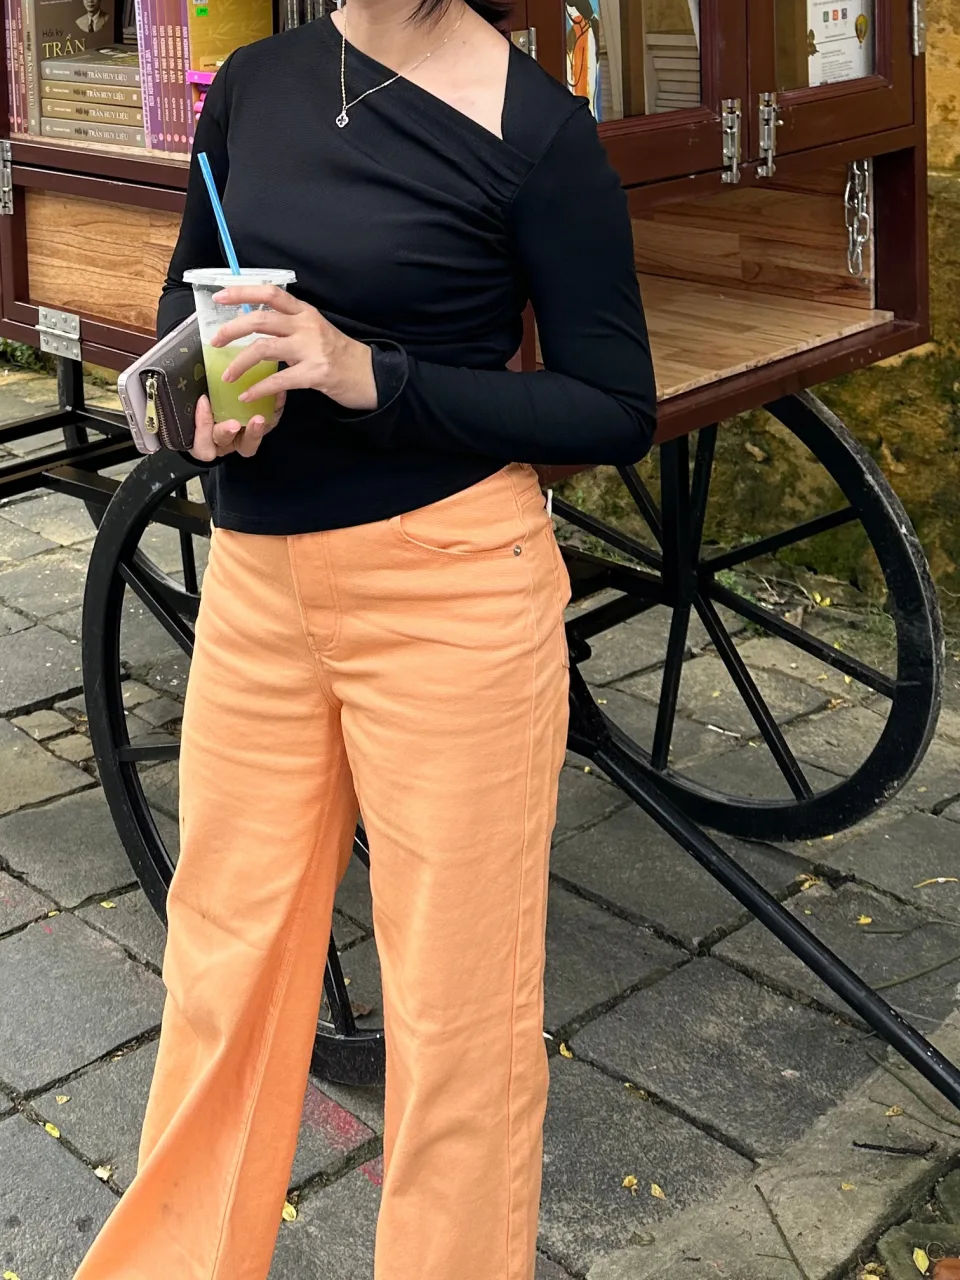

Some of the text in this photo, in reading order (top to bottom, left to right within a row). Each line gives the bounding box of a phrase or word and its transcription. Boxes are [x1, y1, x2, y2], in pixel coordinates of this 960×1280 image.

[42, 35, 86, 58] TRẦN
[87, 70, 102, 79] TRẦN
[114, 72, 127, 81] LIỆU
[86, 89, 100, 98] TRẦN
[101, 91, 112, 99] HUY
[113, 92, 125, 100] LIỆU
[89, 108, 104, 117] TRẦN
[116, 112, 128, 120] LIỆU
[88, 129, 103, 137] TRẦN
[116, 132, 128, 140] LIỆU
